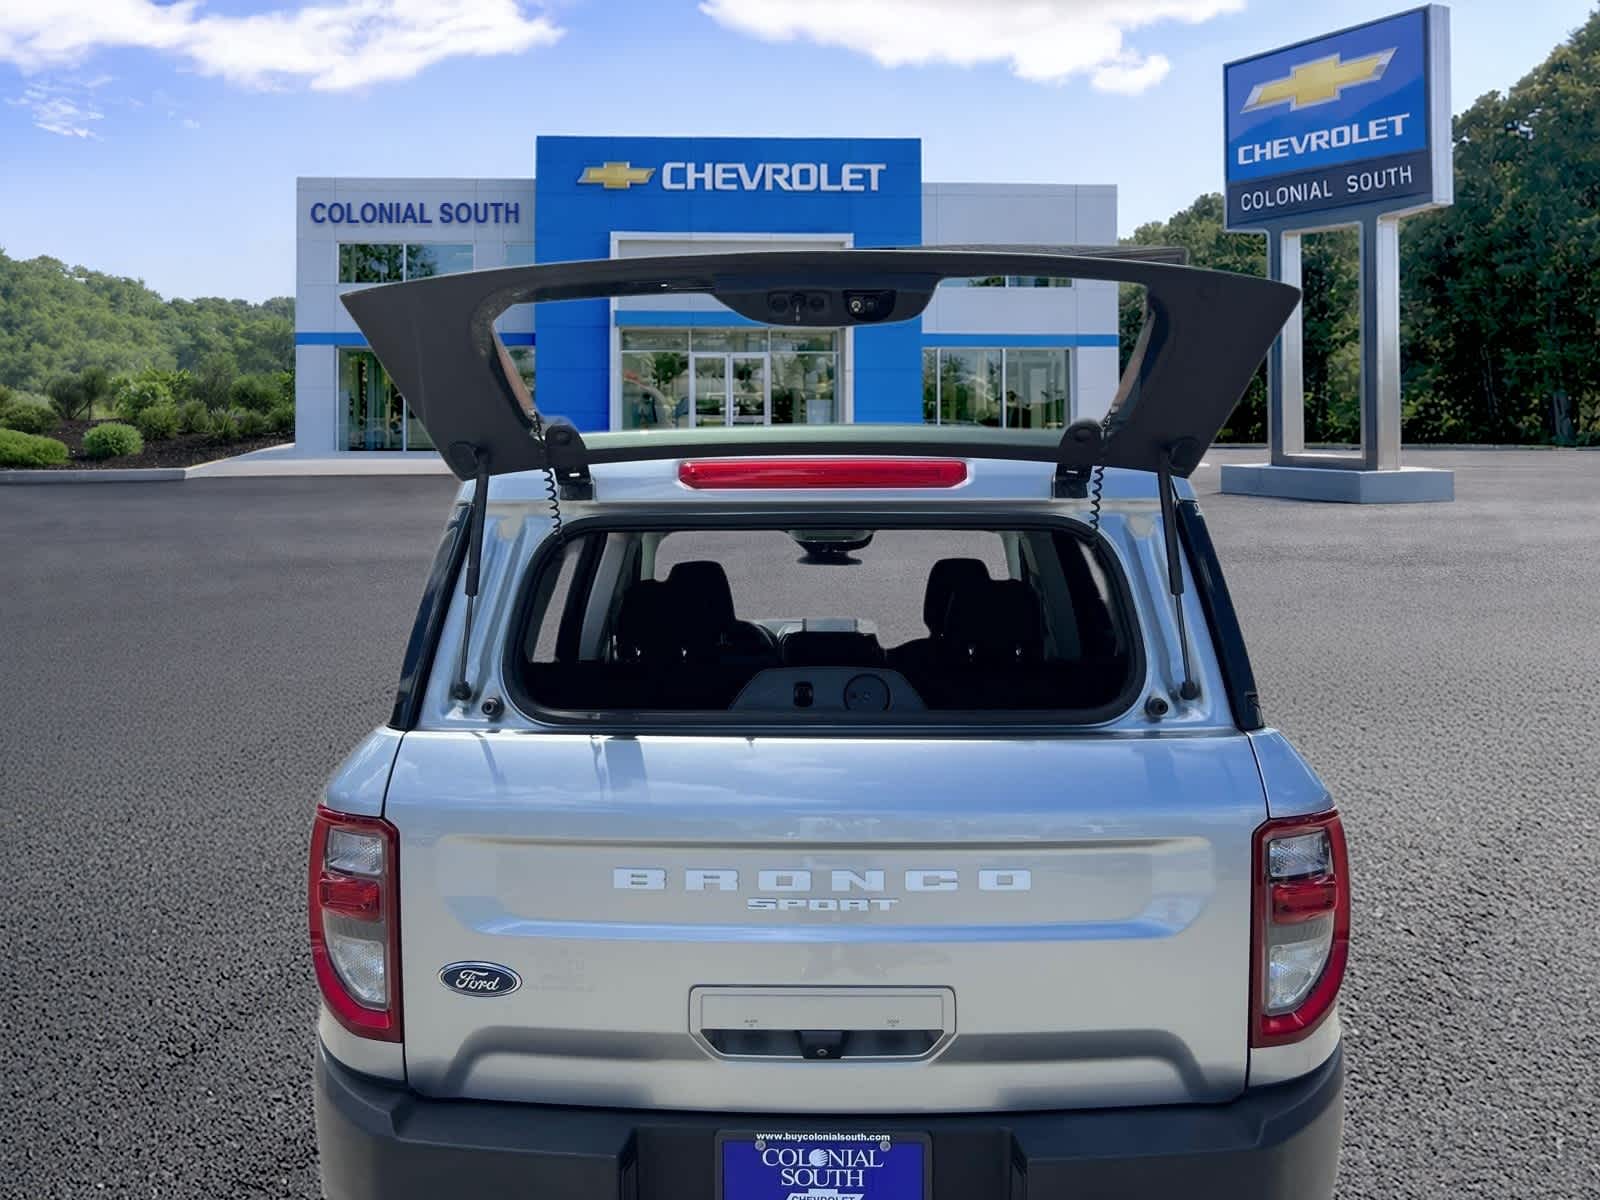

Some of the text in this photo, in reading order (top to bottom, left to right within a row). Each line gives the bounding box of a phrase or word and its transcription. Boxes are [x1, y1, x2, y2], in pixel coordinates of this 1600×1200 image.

[1237, 112, 1411, 166] CHEVROLET
[662, 161, 887, 192] CHEVROLET
[1240, 165, 1413, 212] COLONIAL SOUTH
[310, 202, 520, 225] COLONIAL SOUTH
[612, 867, 1033, 892] BRONCO
[747, 897, 900, 911] SPORT
[455, 968, 501, 992] Ford
[755, 1132, 891, 1143] www.buycolonialsouth.com
[761, 1148, 884, 1168] COLONIAL
[780, 1168, 865, 1188] SOUTH
